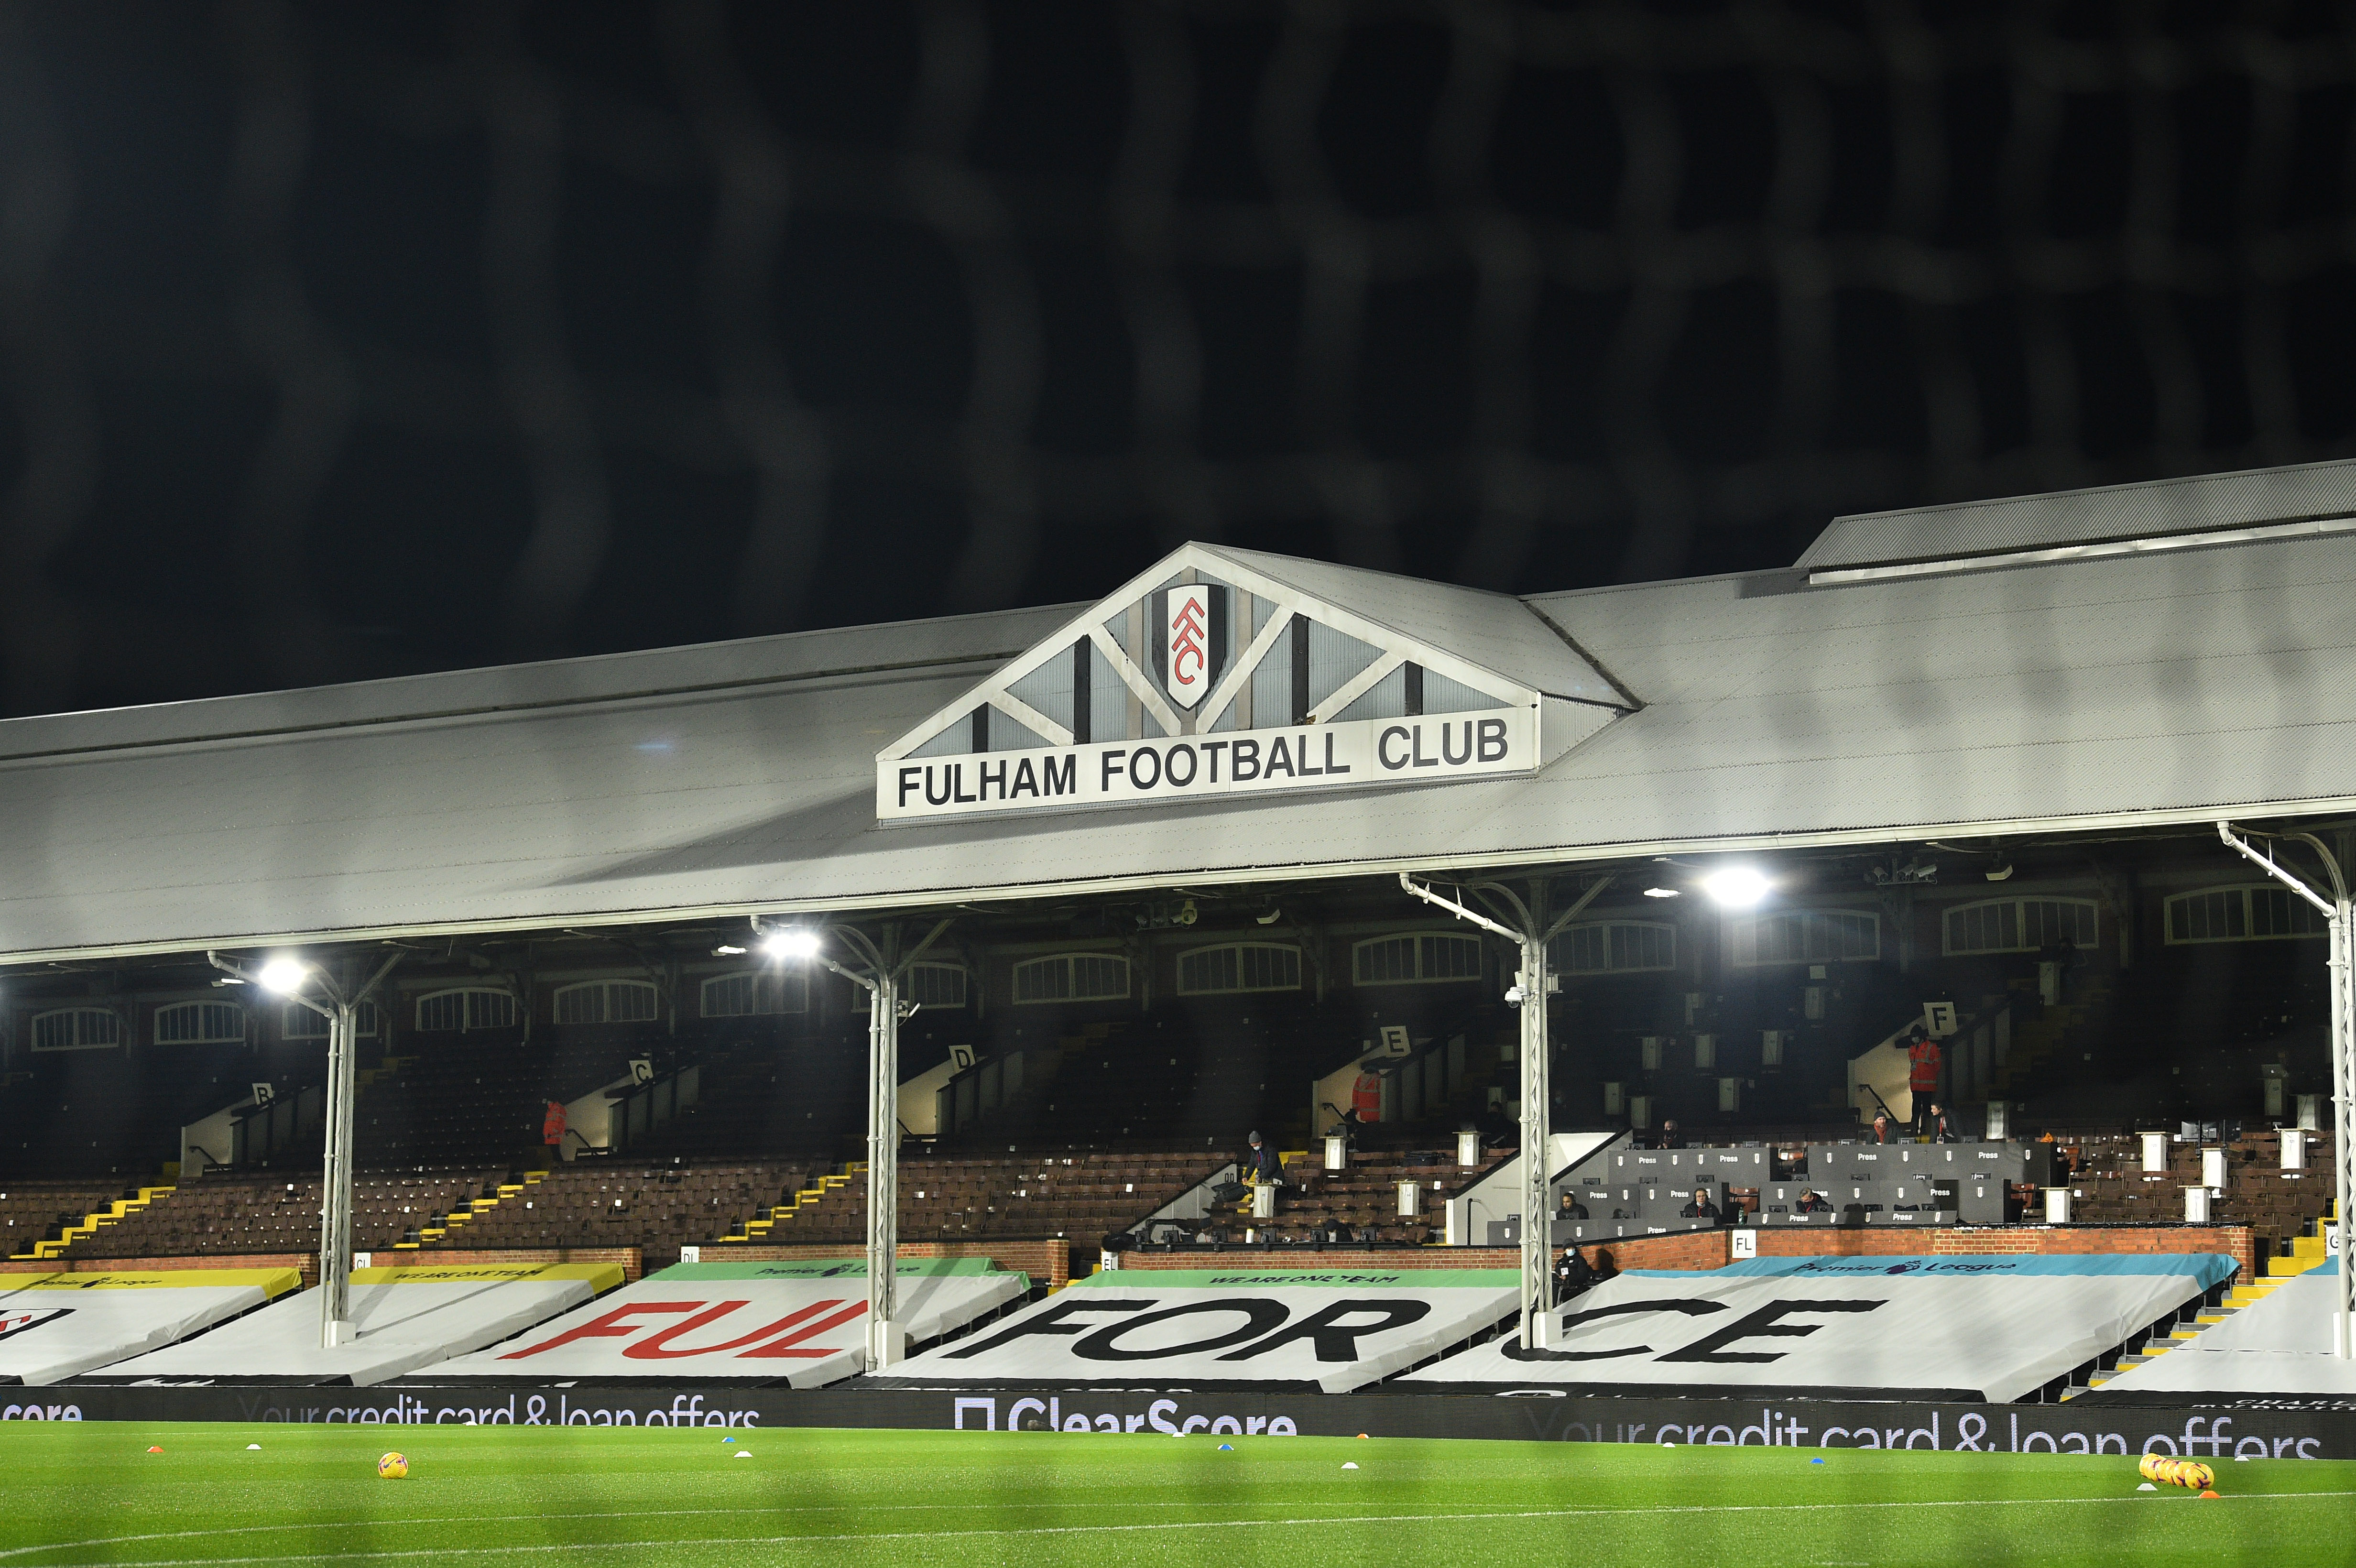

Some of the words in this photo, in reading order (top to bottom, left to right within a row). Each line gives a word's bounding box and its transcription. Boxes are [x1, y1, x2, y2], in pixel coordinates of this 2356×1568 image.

[1171, 597, 1205, 685] FFC
[899, 754, 1076, 807] FULHAM
[1102, 732, 1351, 792] FOOTBALL
[1378, 718, 1508, 770] CLUB
[1932, 1007, 1947, 1031] F
[1386, 1031, 1404, 1053] E
[955, 1049, 971, 1069] D
[635, 1064, 649, 1081] C
[258, 1088, 268, 1102] B
[1736, 1238, 1752, 1251] FL
[1104, 1259, 1115, 1271] EL
[1793, 1263, 1884, 1272] Premier
[1923, 1263, 2017, 1272] League
[1339, 1275, 1400, 1283] TEAM
[494, 1299, 868, 1360] FUL
[938, 1298, 1431, 1362] FOR
[1500, 1298, 1890, 1363] CE
[325, 1394, 429, 1425] credit
[436, 1394, 514, 1425] card
[526, 1394, 552, 1426] &
[561, 1394, 637, 1426] loan
[645, 1394, 760, 1428] offers
[1008, 1397, 1297, 1436] ClearScore
[1656, 1408, 1809, 1448] credit
[1820, 1411, 1939, 1450] card
[1954, 1412, 1996, 1452] &
[2011, 1413, 2127, 1456] loan
[2142, 1416, 2322, 1460] offers
